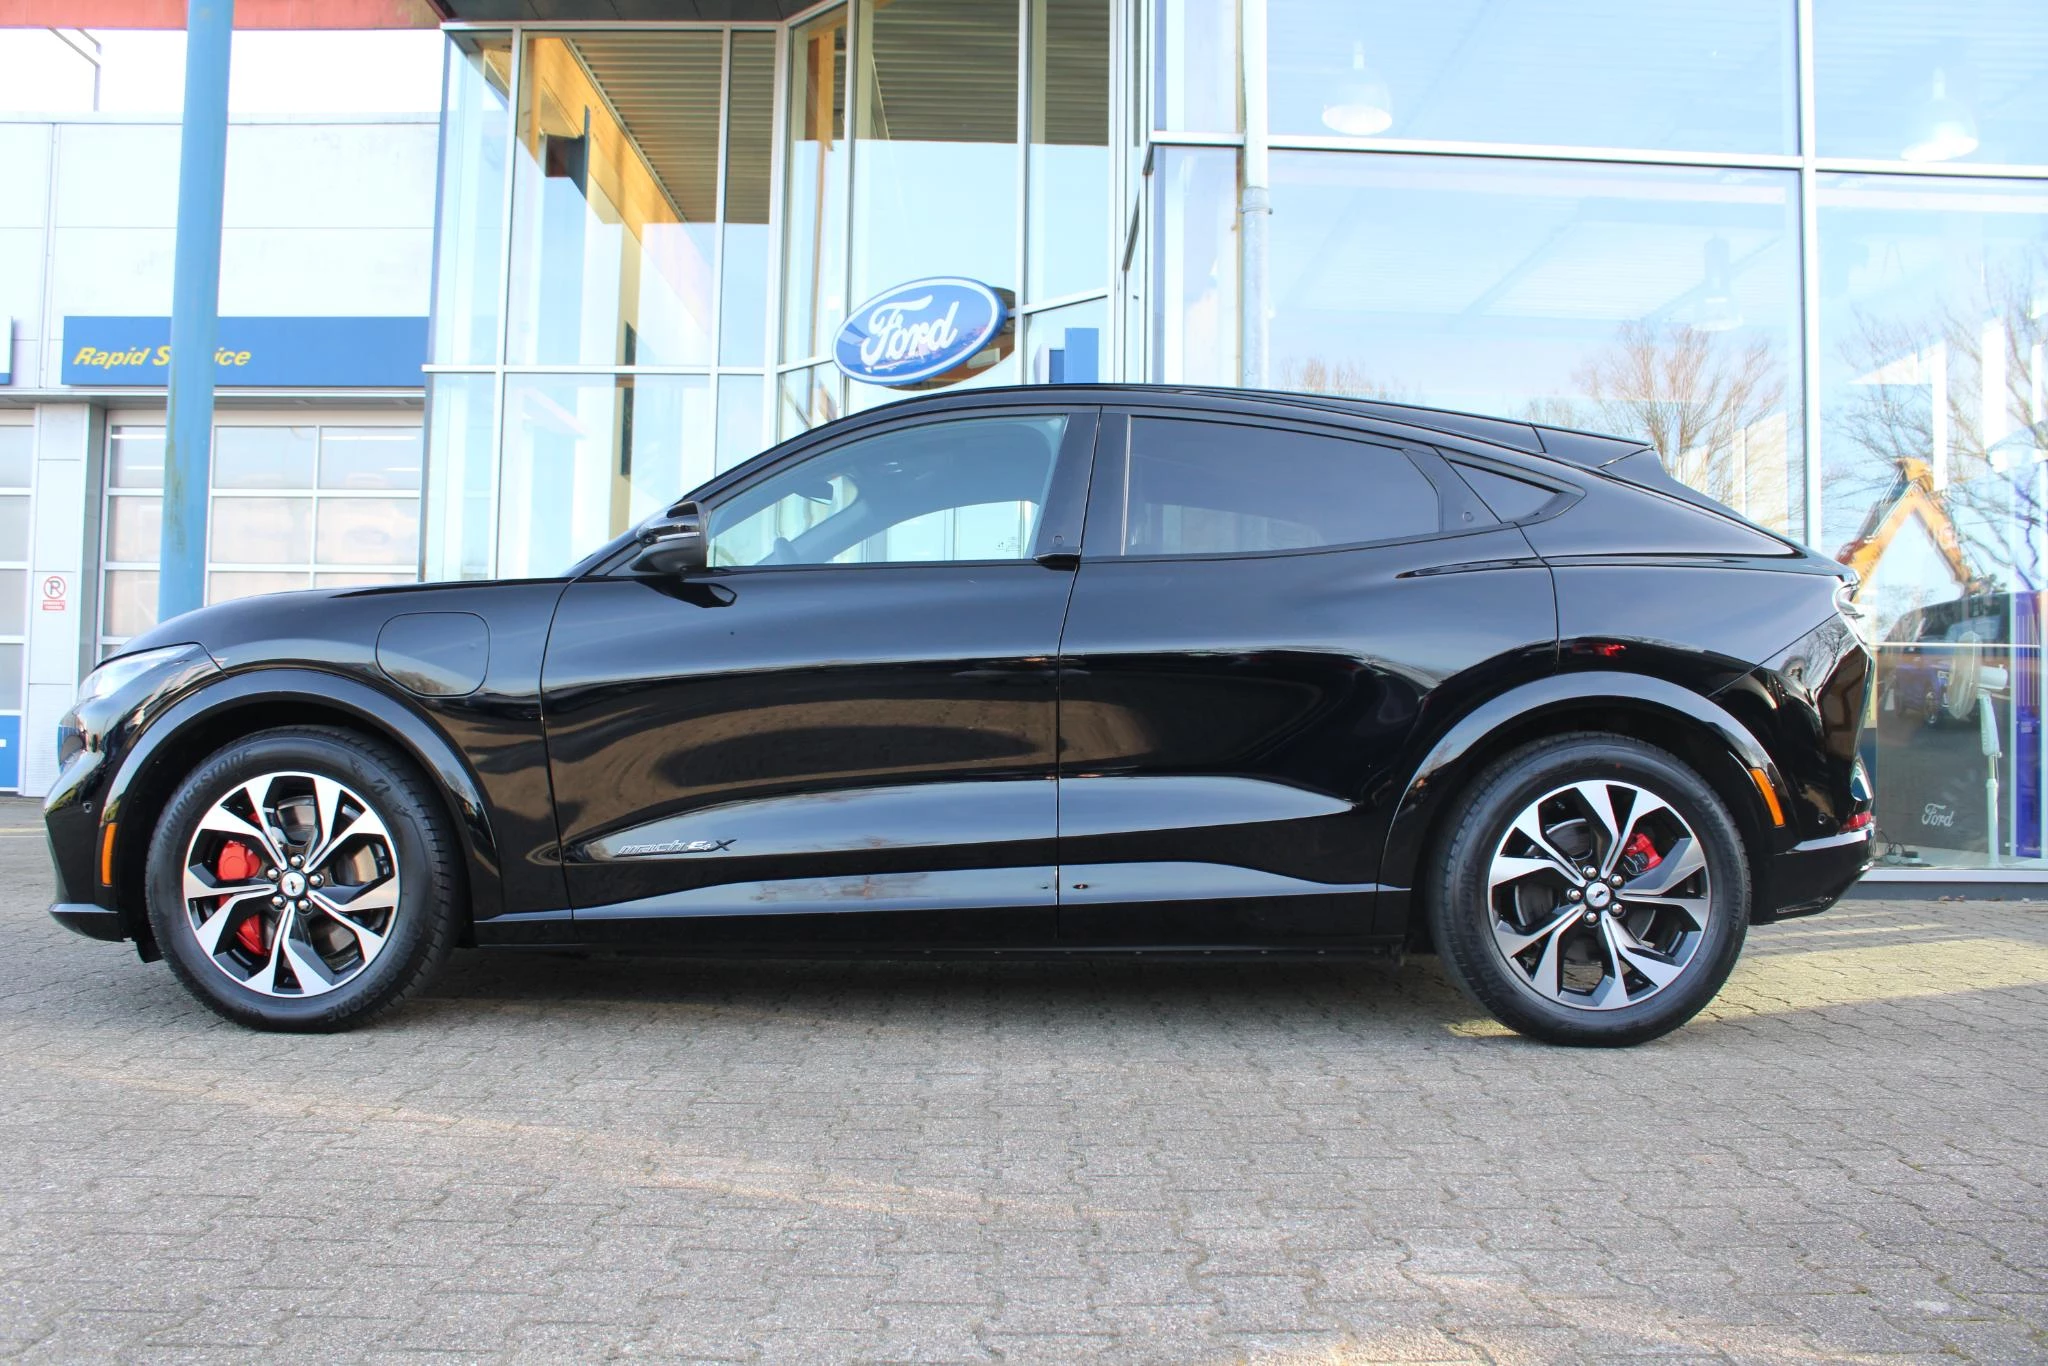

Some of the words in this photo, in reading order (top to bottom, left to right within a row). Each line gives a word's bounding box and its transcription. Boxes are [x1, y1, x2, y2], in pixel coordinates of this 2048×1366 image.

[861, 294, 960, 366] Ford
[73, 346, 151, 369] Rapid
[152, 345, 251, 366] Sice
[1921, 803, 1954, 827] Ford
